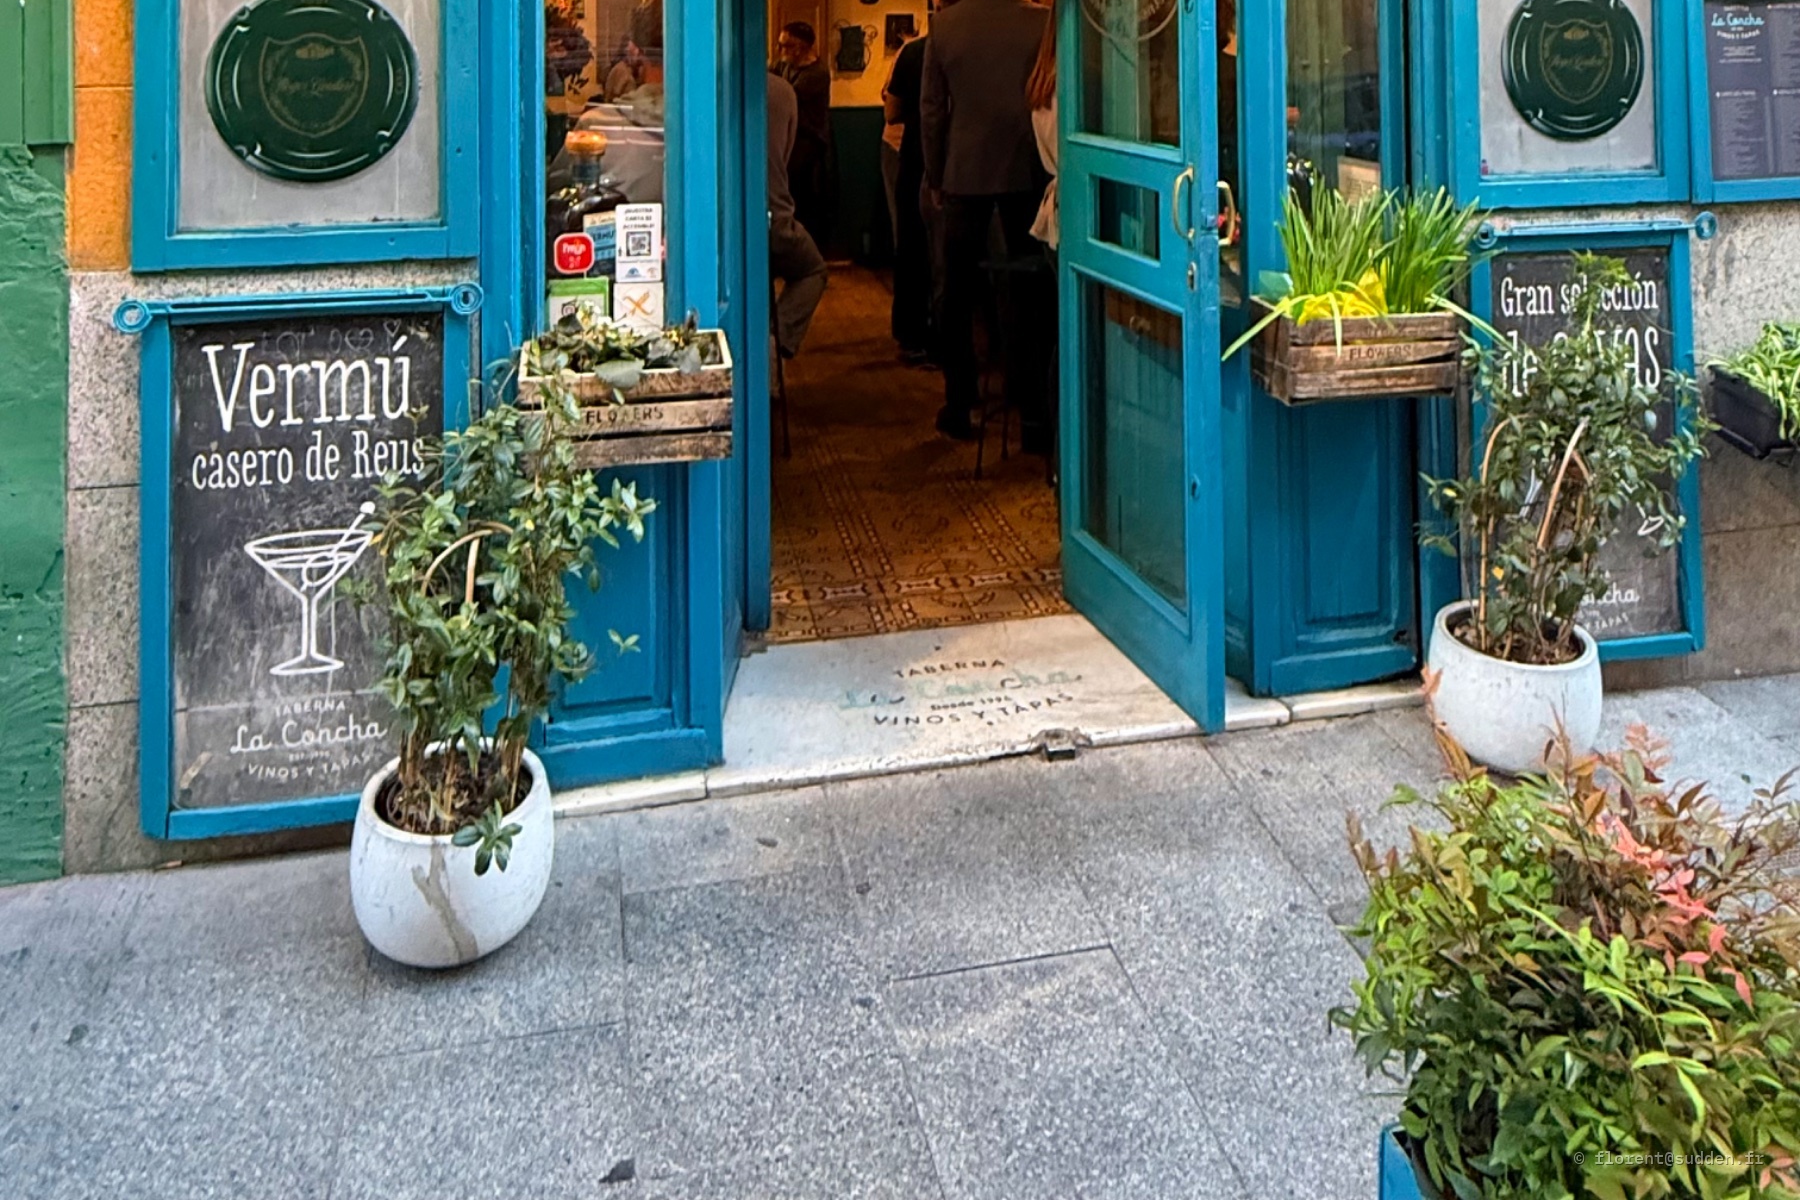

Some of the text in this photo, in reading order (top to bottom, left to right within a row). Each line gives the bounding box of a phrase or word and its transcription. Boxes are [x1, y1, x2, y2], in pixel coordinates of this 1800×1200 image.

[1501, 277, 1555, 317] Gran
[202, 335, 410, 433] Vermú
[192, 429, 425, 490] casero de Reus
[894, 659, 1006, 679] TABERNA
[275, 700, 346, 717] TABERNA
[873, 711, 961, 726] VINOS
[1000, 691, 1074, 717] TAPAS
[230, 713, 389, 755] La Concha
[248, 763, 299, 779] VINOS
[306, 766, 314, 776] Y
